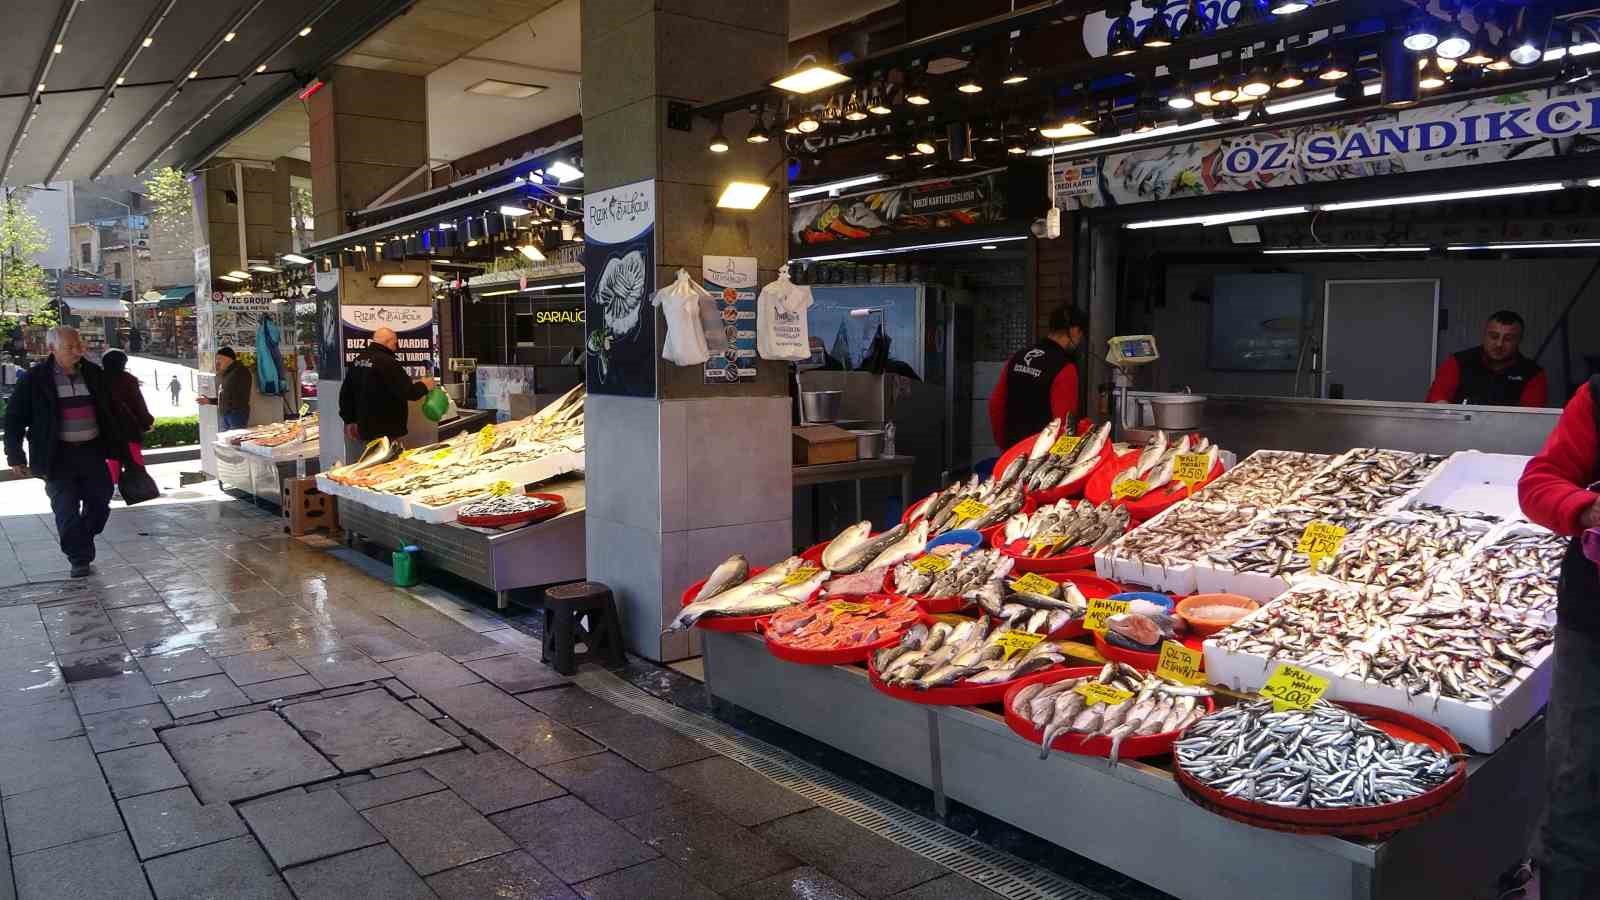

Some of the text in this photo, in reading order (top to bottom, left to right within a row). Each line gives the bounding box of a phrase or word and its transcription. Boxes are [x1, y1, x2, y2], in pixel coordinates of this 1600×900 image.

[1226, 139, 1289, 174] ÖZ
[347, 339, 366, 349] BUZ
[398, 338, 429, 349] VARDIR
